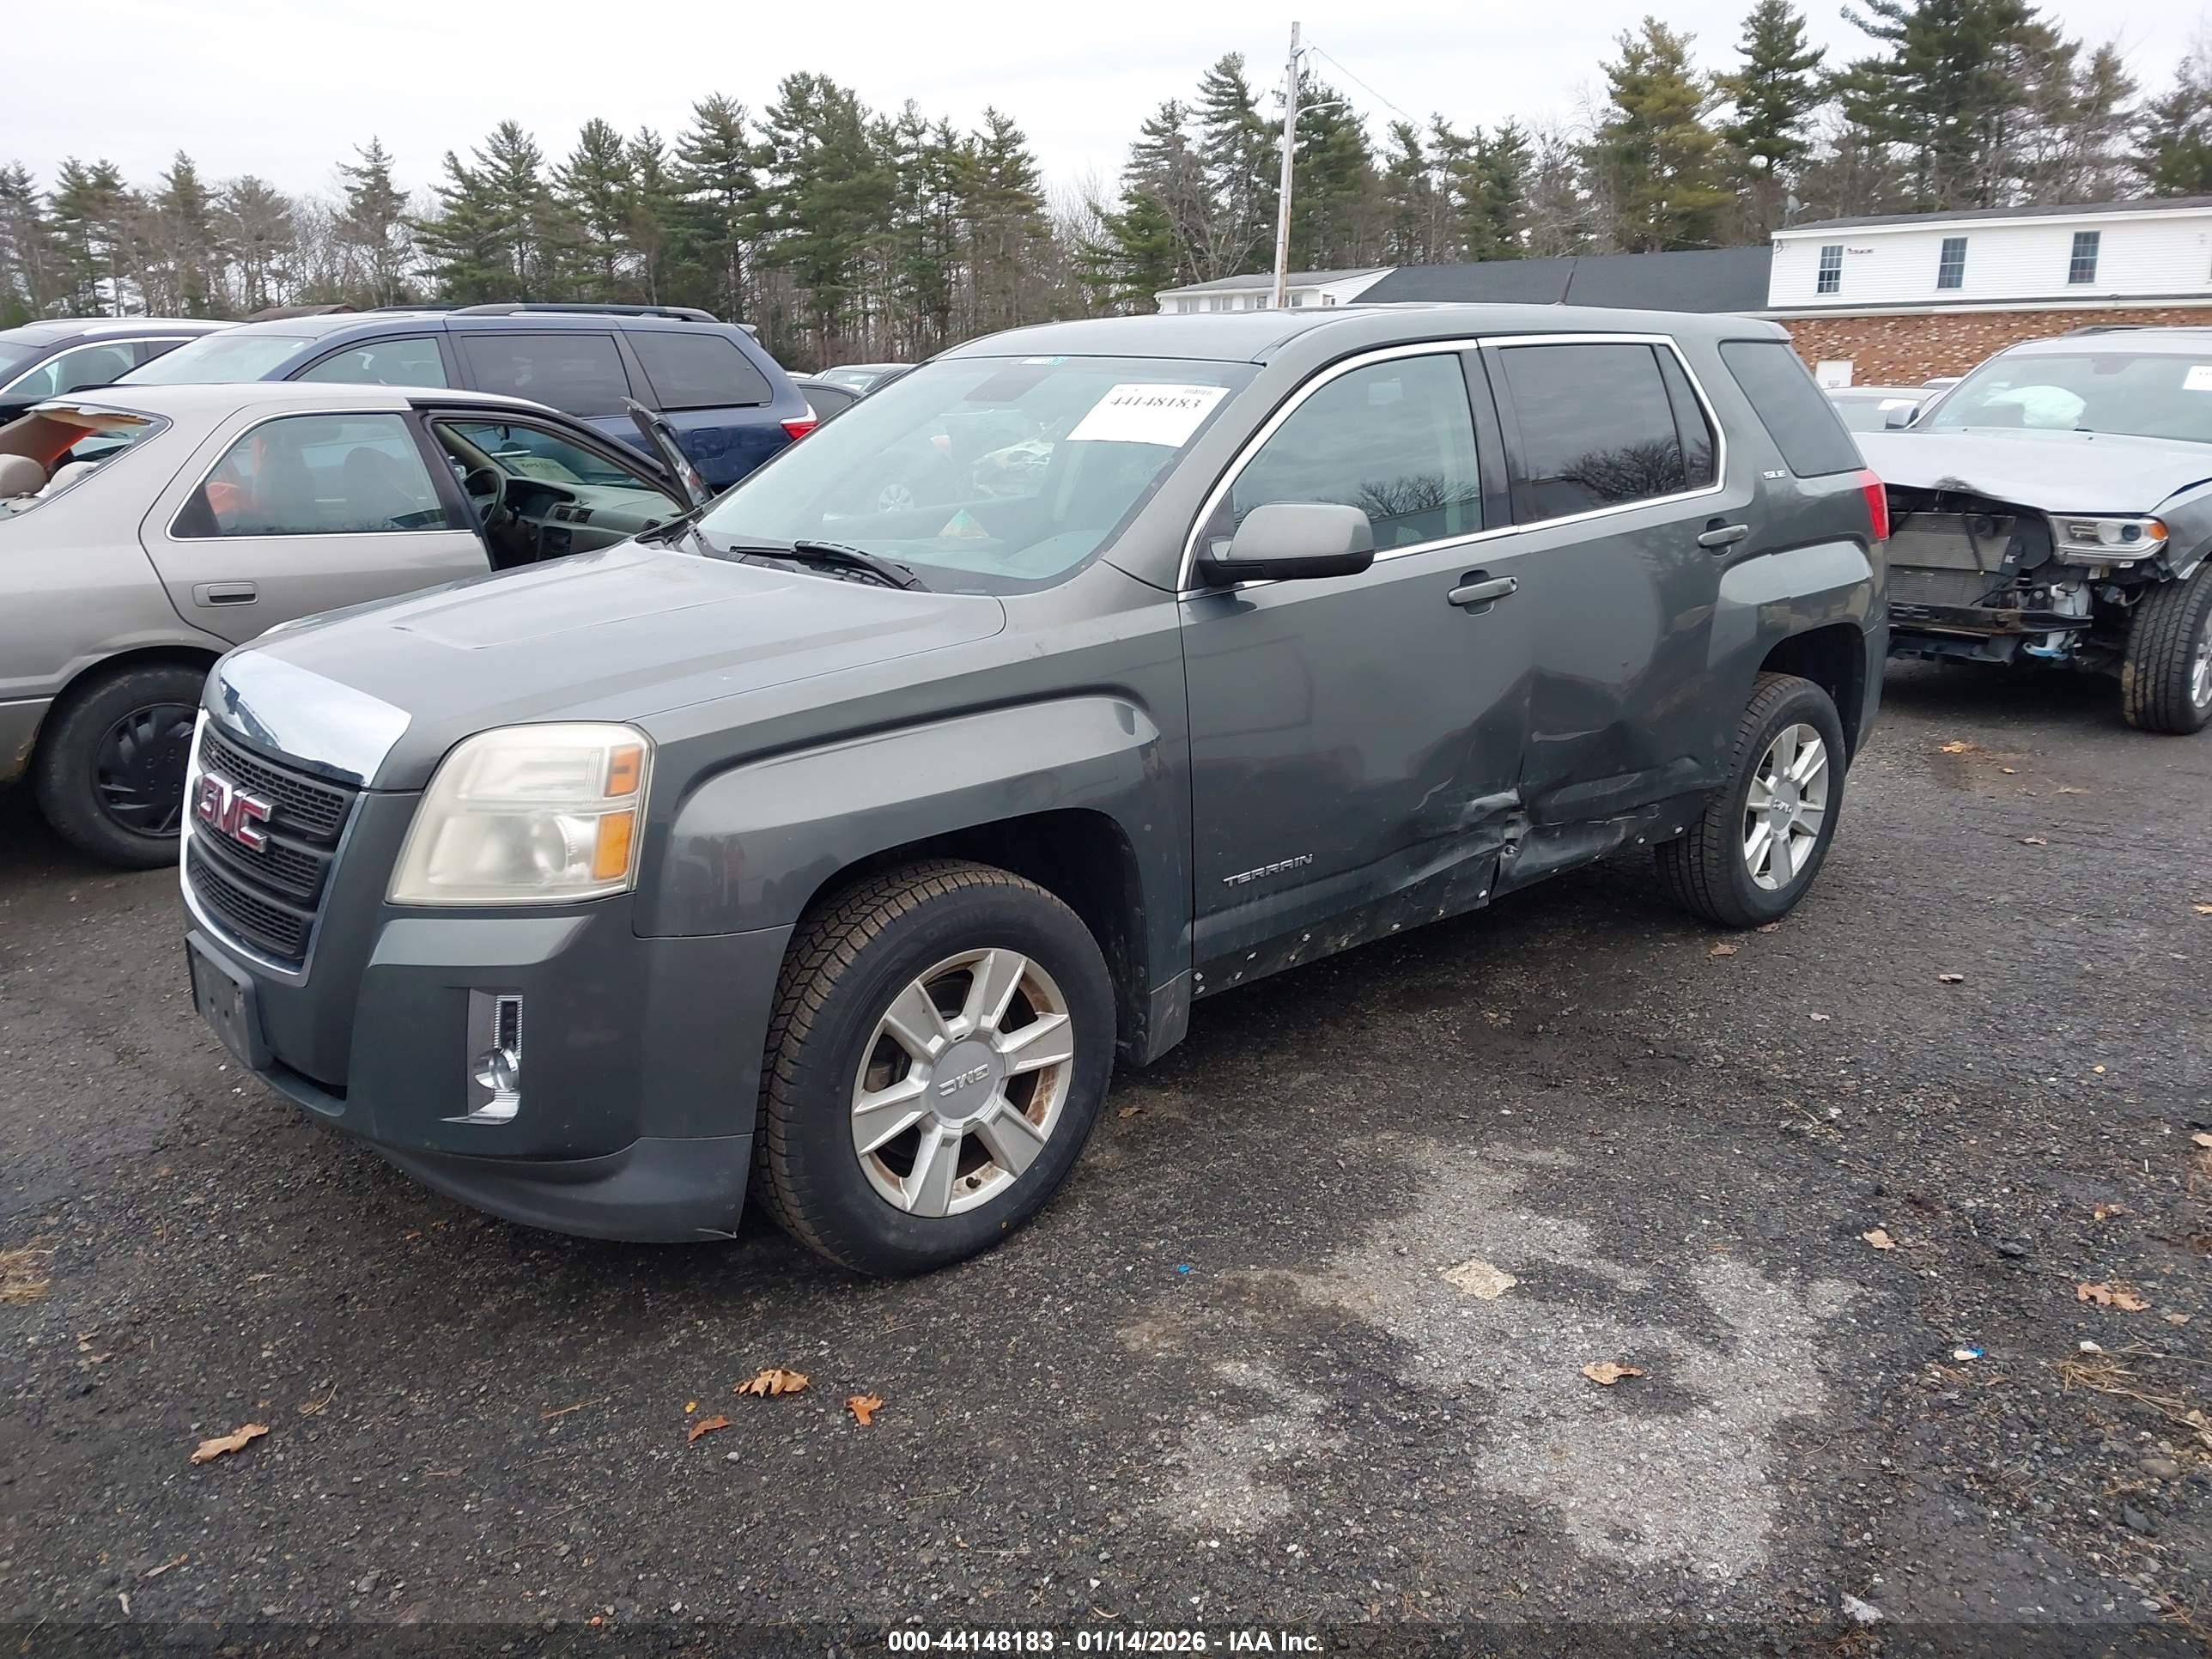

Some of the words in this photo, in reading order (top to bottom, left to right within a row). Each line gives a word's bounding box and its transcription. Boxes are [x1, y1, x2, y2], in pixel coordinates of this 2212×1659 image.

[1763, 469, 1787, 479] SLE
[198, 772, 272, 853] GMC
[1223, 854, 1313, 887] TERRAIN
